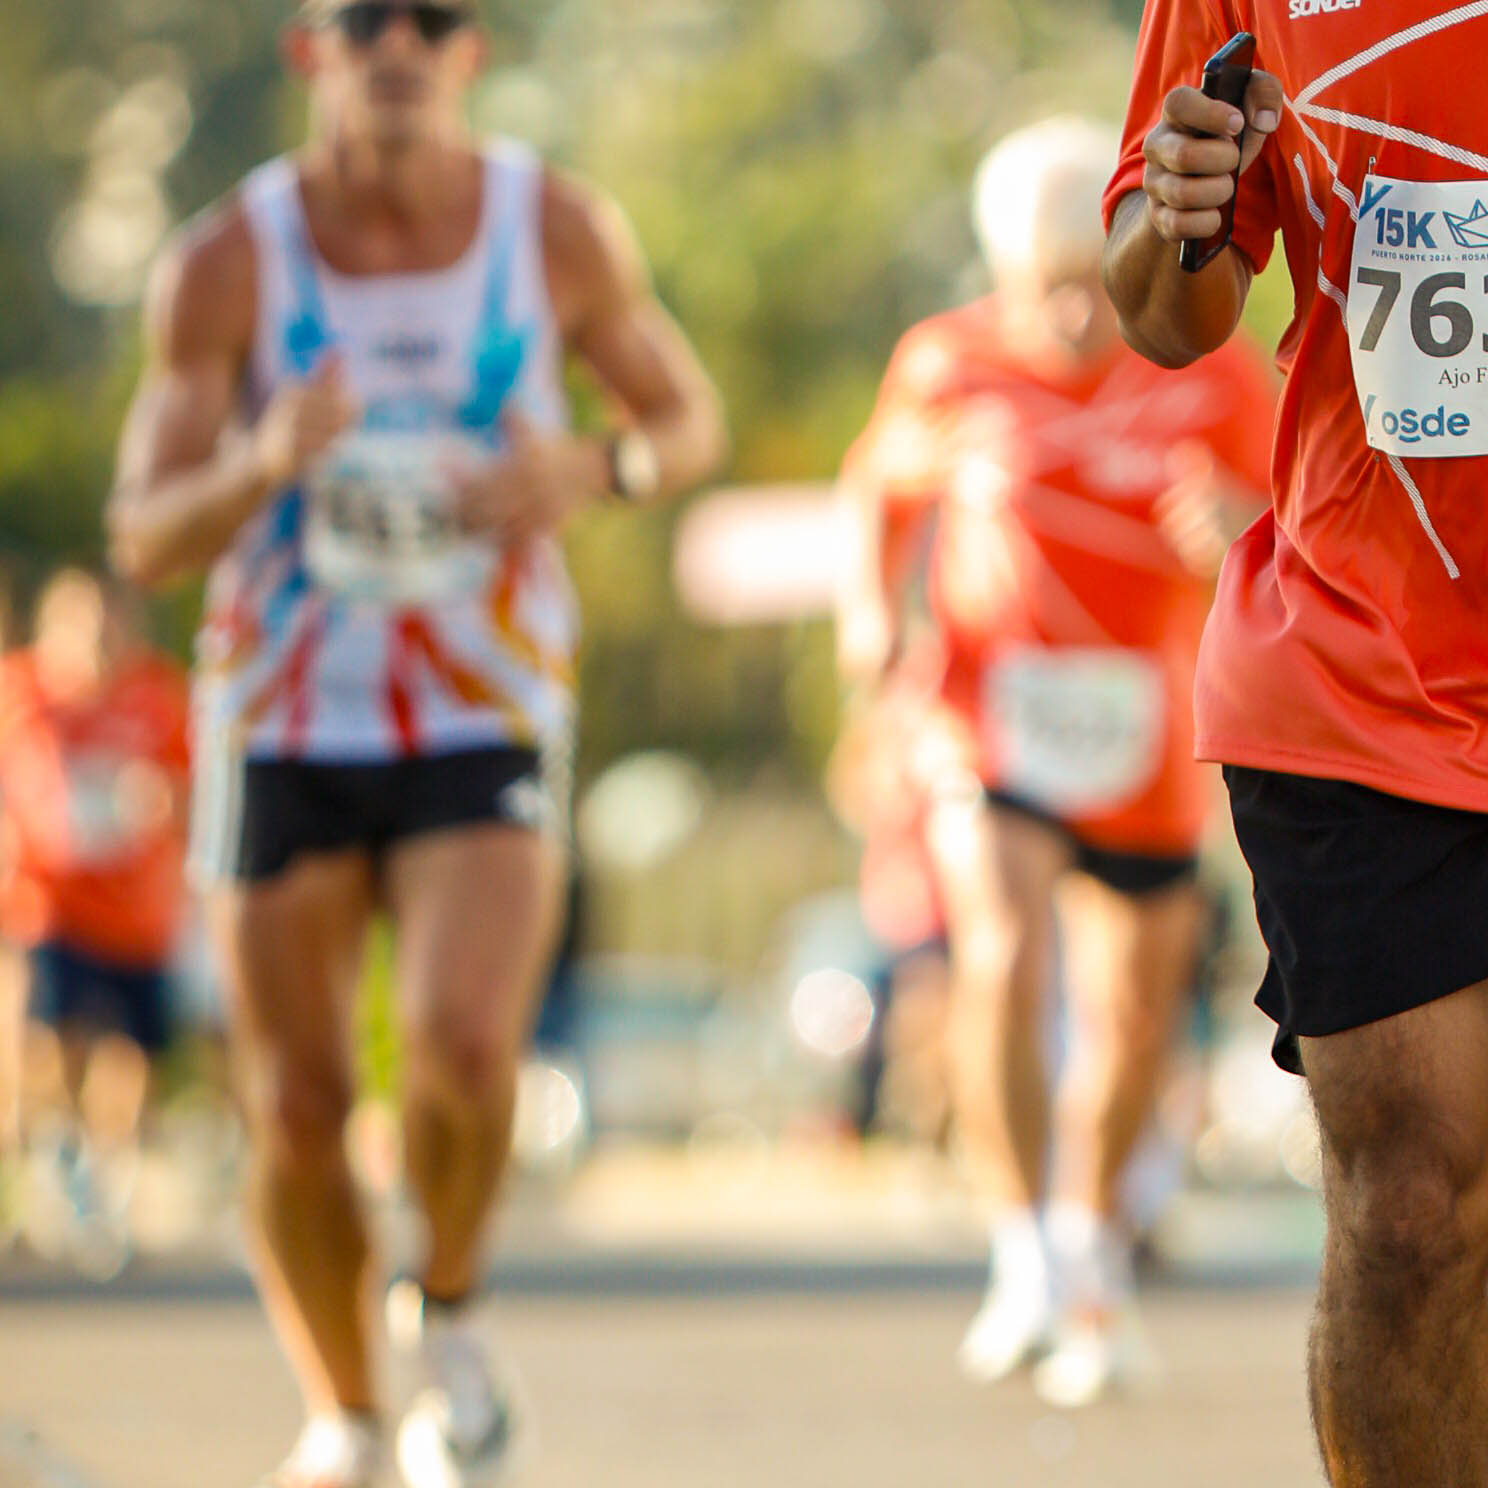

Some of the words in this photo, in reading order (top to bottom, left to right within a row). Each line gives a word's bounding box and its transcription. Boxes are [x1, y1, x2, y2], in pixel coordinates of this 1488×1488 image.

[1375, 207, 1438, 249] 15K
[1371, 249, 1397, 260] PUERTO
[1399, 252, 1426, 262] NORTE
[1438, 368, 1471, 389] Ajo
[1381, 405, 1471, 438] osde
